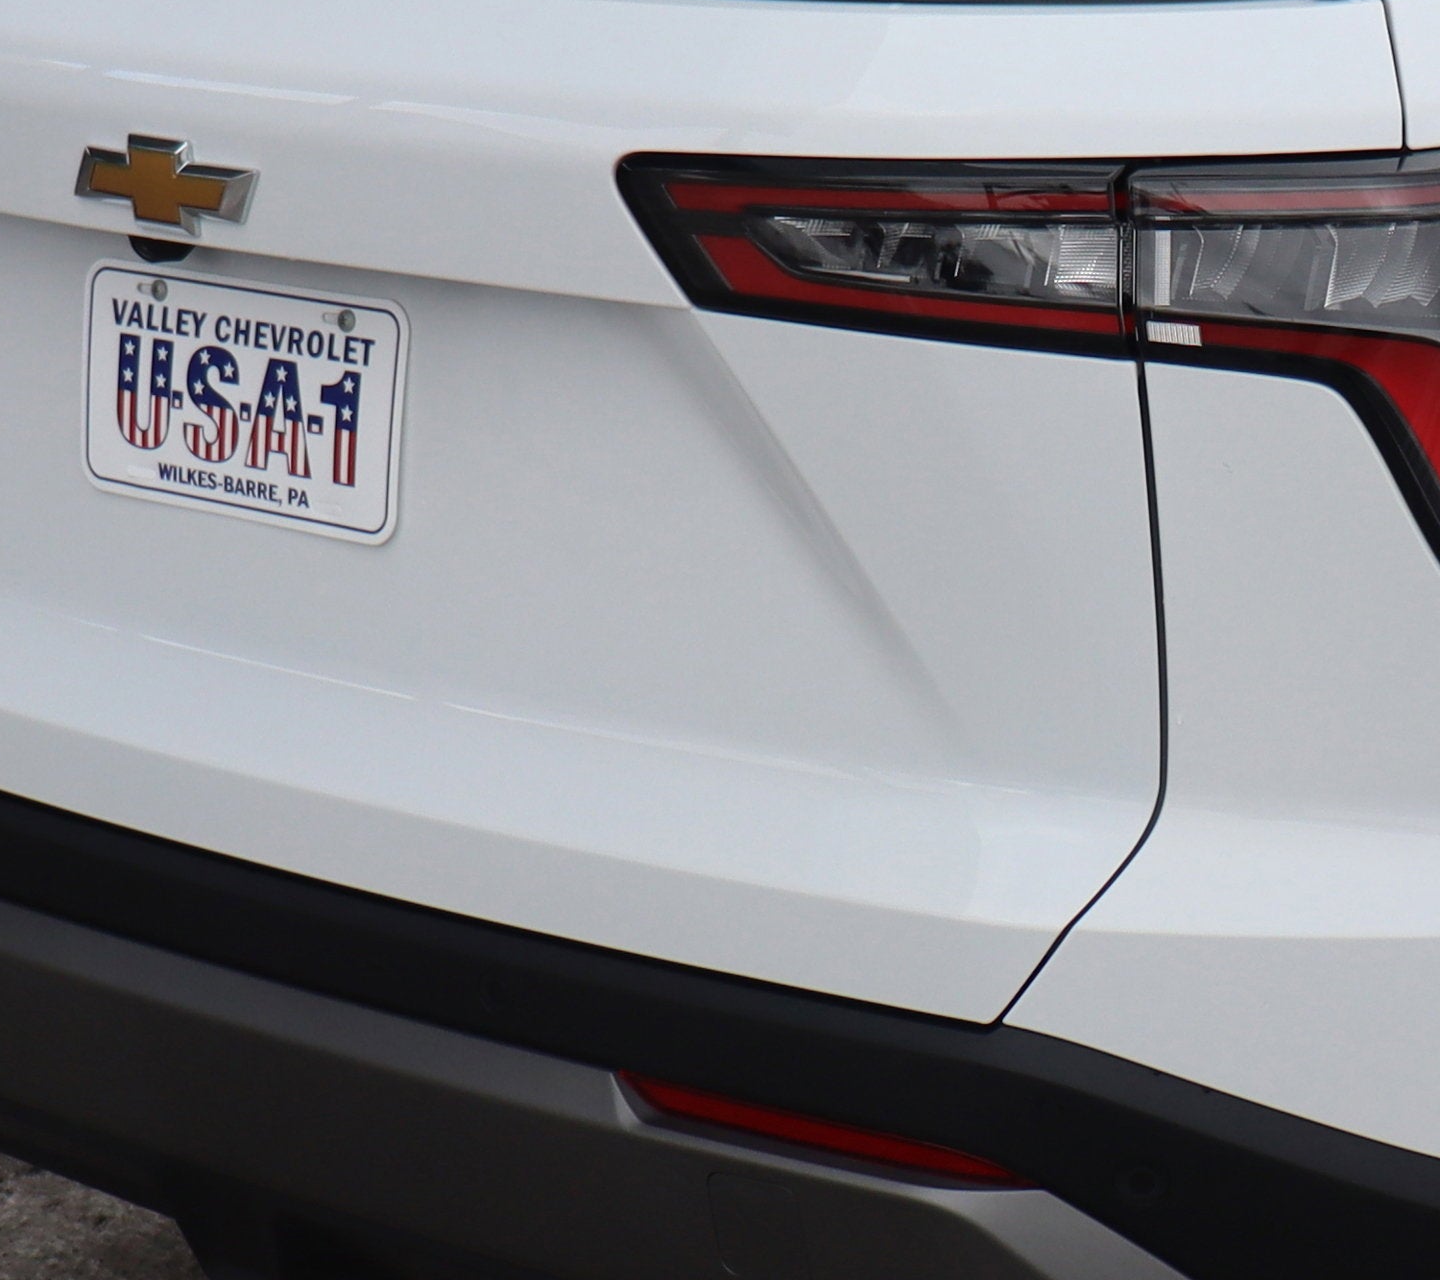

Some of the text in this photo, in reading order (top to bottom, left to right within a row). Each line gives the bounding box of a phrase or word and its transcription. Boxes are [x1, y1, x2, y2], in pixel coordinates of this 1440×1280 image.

[112, 297, 376, 367] VALLEY CHEVROLET
[157, 462, 310, 508] WILKES-BARRE, PA
